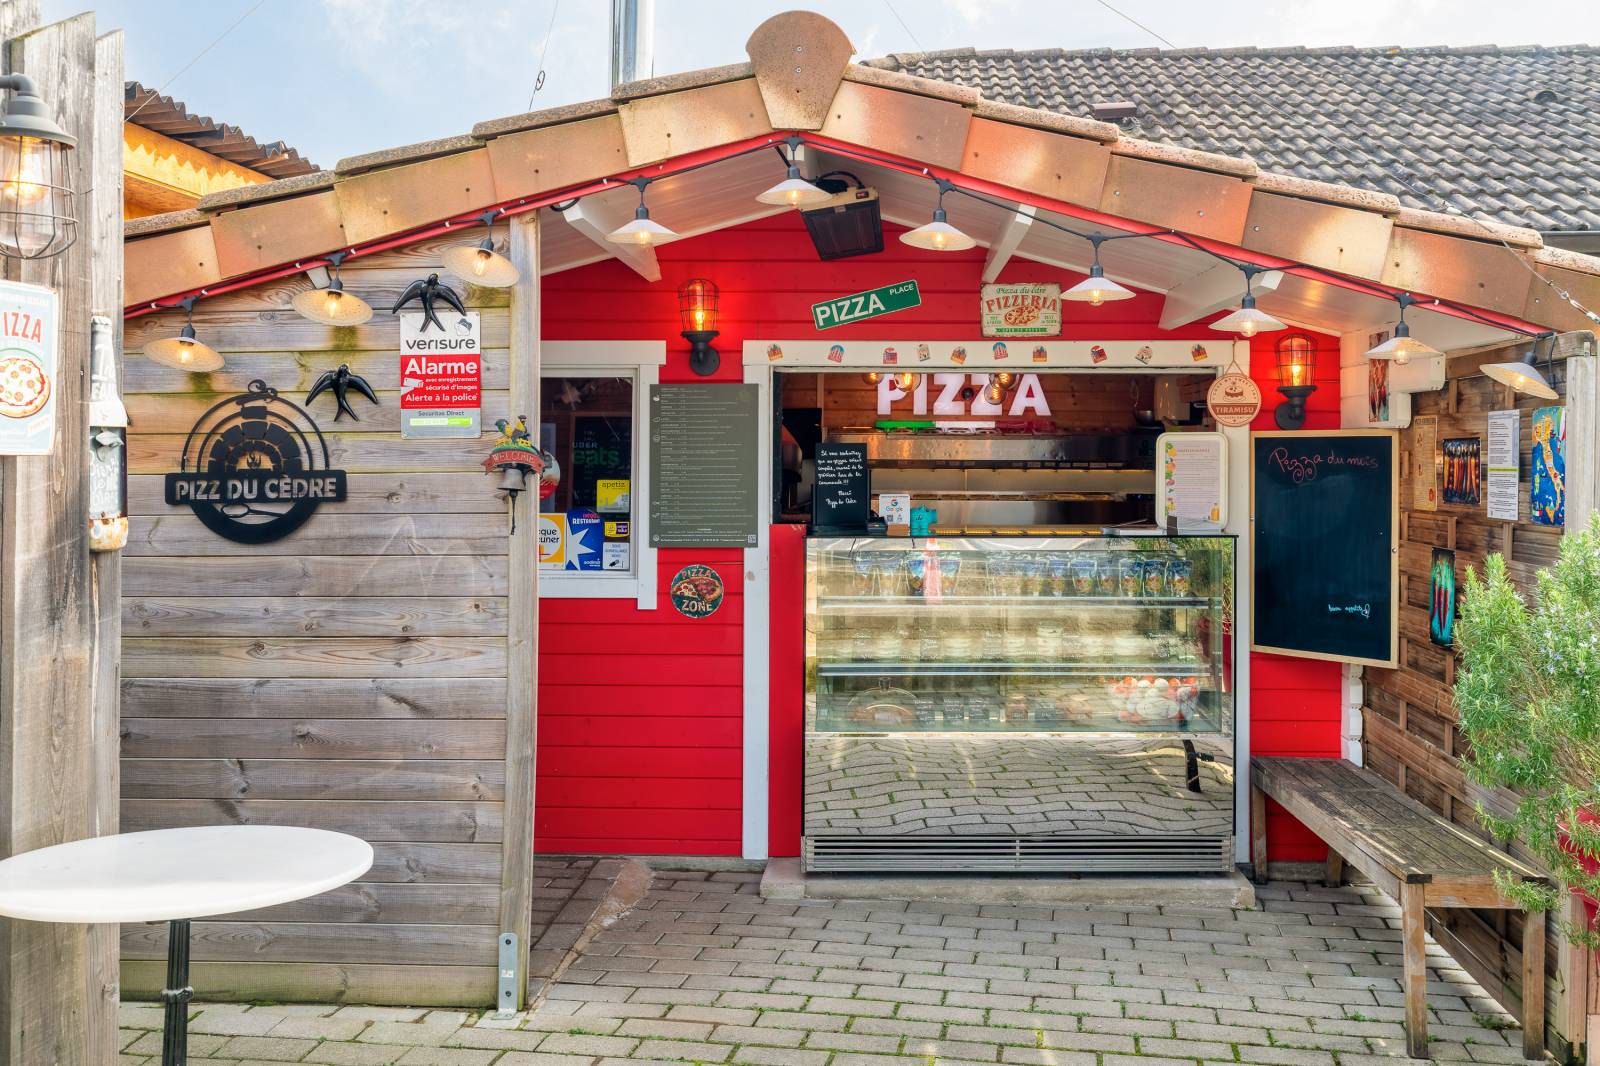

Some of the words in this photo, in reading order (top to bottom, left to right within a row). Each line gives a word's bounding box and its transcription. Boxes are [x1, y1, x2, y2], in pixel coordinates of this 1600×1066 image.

[889, 284, 915, 297] PLACE
[815, 294, 885, 327] PIZZA
[986, 295, 1057, 313] PIZZERIA
[406, 339, 476, 350] verisure
[405, 357, 478, 375] Alarme
[405, 394, 433, 402] Alerte
[442, 393, 450, 401] la
[877, 373, 1051, 416] PIZZA
[492, 452, 534, 463] WELCOME
[572, 448, 619, 466] eats
[1327, 450, 1345, 464] du
[1346, 456, 1379, 469] mois
[176, 480, 221, 500] PIZZ
[227, 478, 258, 499] DU
[264, 475, 337, 498] CÈDRE
[681, 568, 712, 579] PIZZA
[682, 600, 714, 612] ZONE
